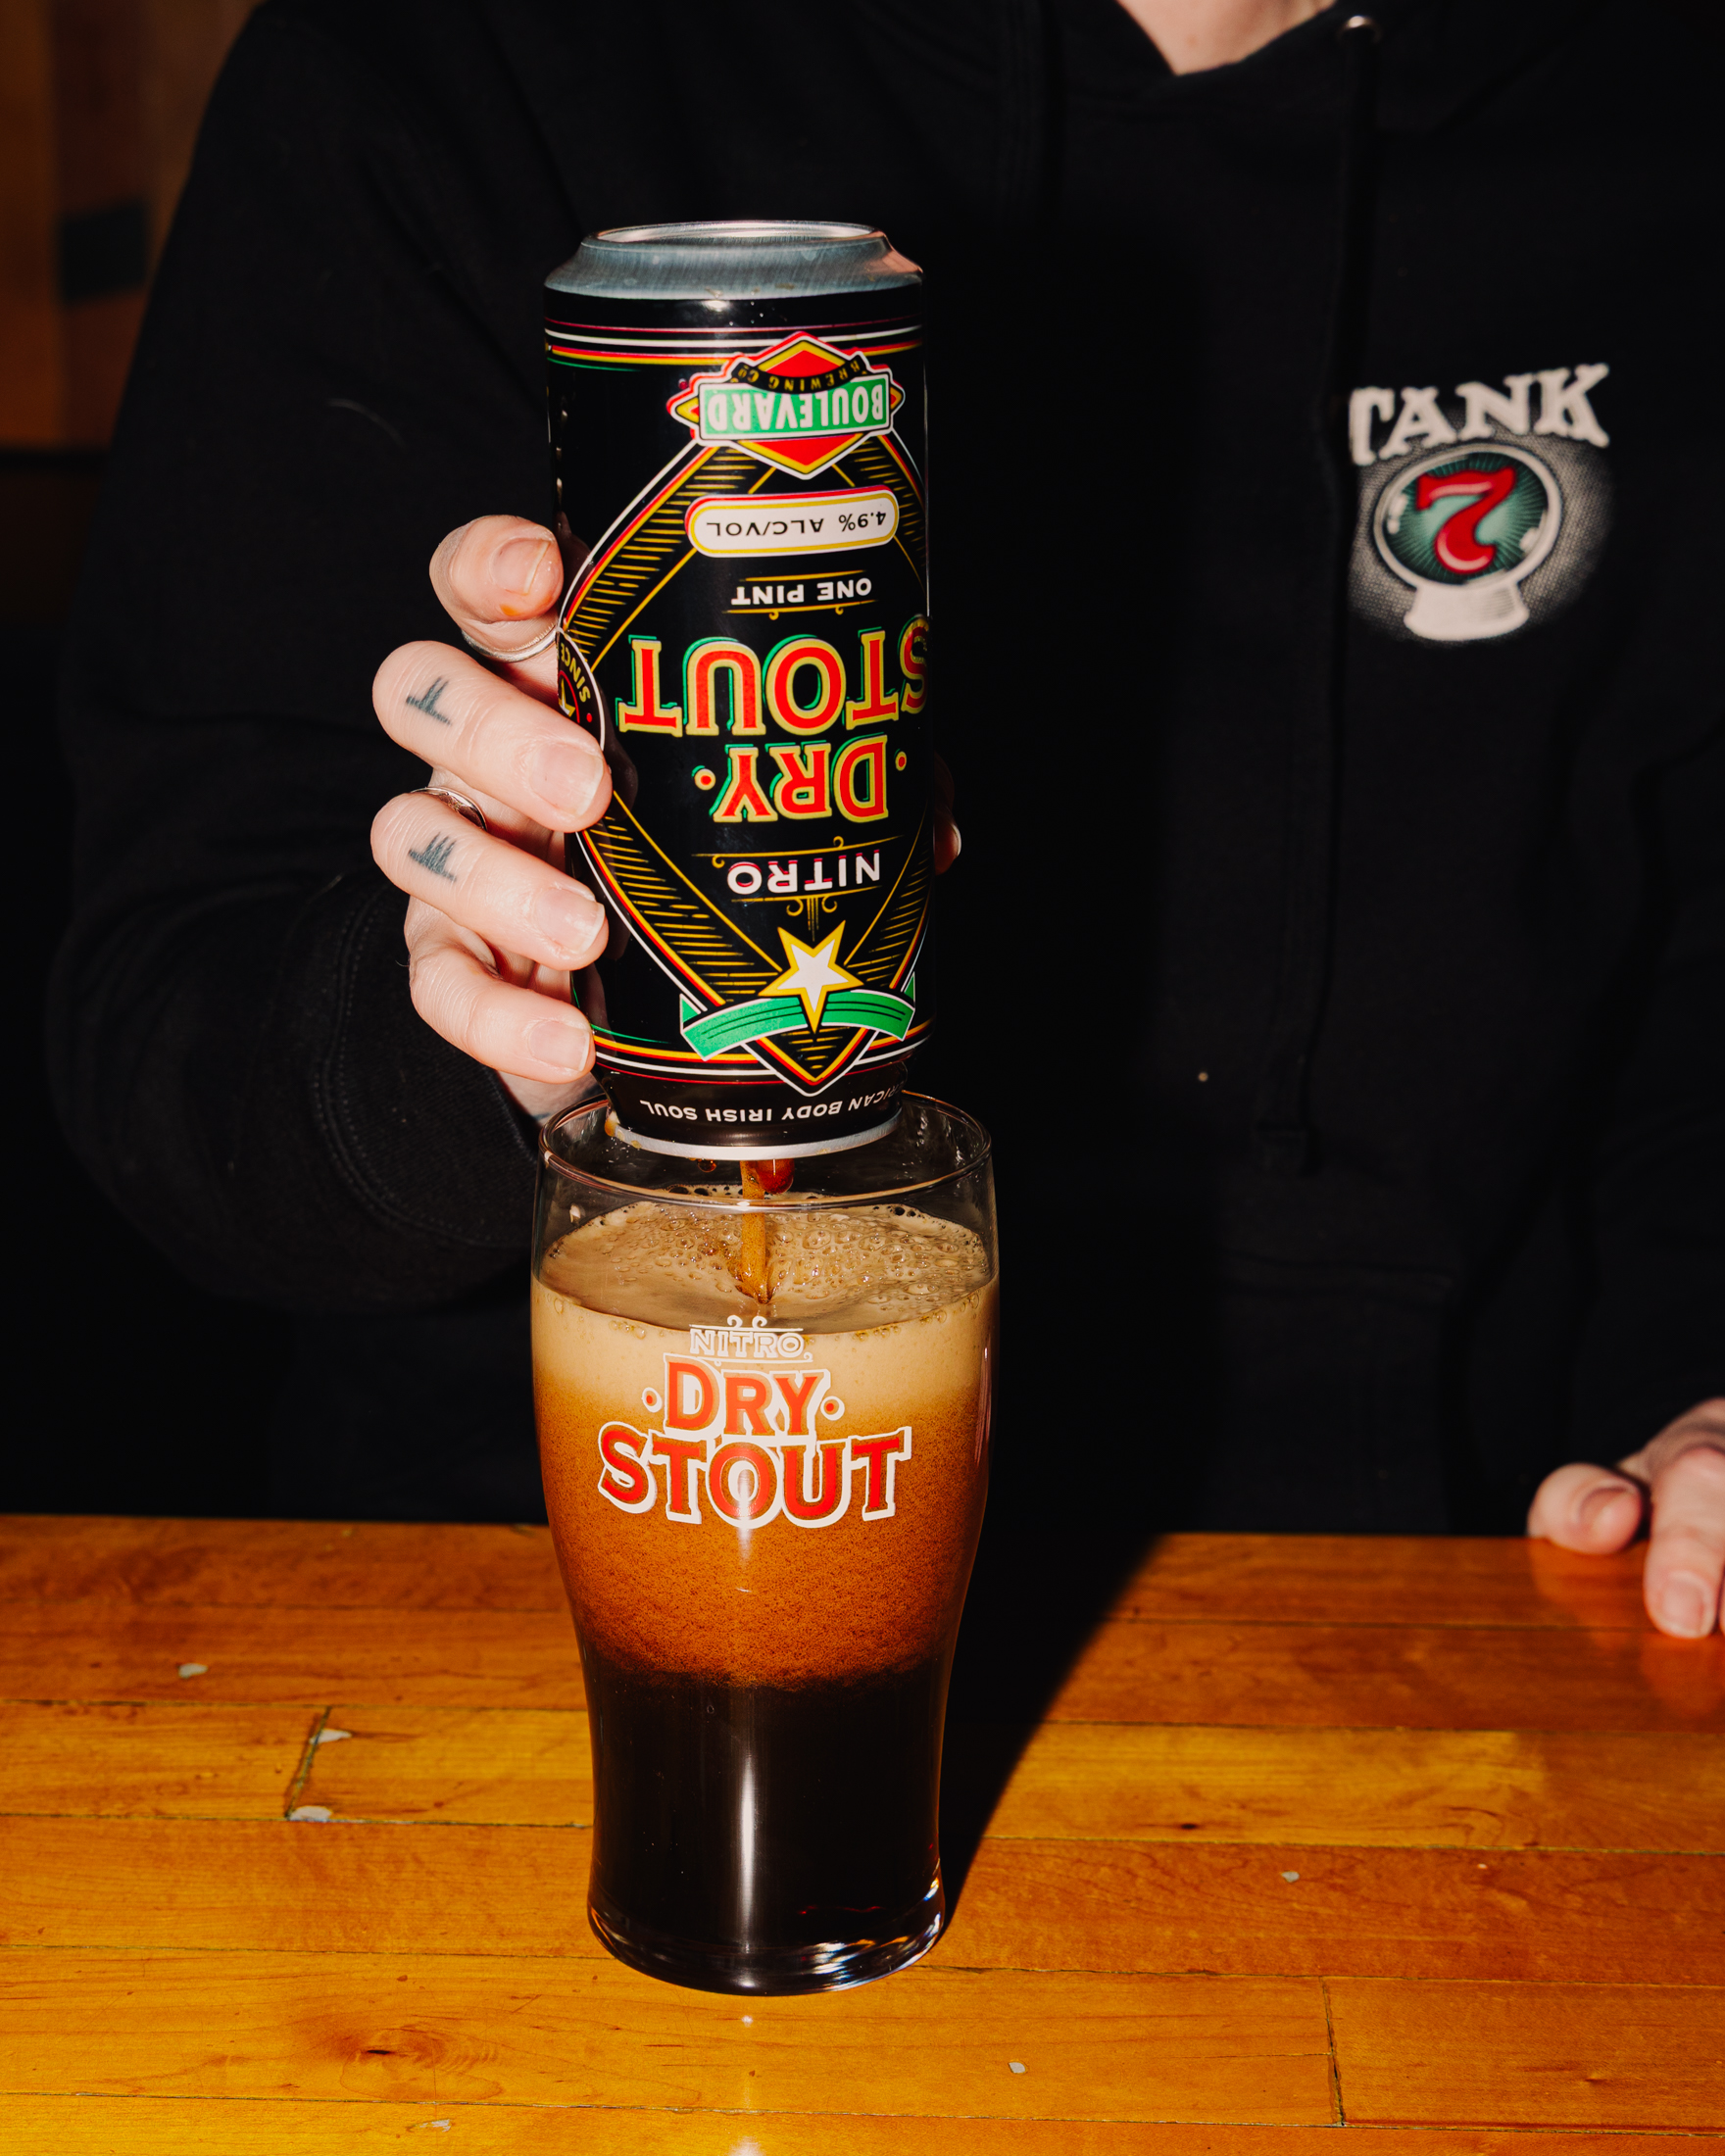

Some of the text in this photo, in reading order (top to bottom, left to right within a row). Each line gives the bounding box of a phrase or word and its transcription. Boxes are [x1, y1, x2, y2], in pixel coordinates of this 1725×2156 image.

[768, 360, 861, 392] BREWING
[708, 383, 883, 432] BOULEVARD
[1349, 362, 1610, 466] TANK
[706, 511, 887, 537] 4.9% ALC/VOL
[1415, 466, 1517, 575] 7
[730, 577, 873, 606] ONE PINT
[560, 641, 592, 704] SINCE
[615, 613, 929, 738] STOUT
[709, 731, 889, 823] DRY
[726, 850, 881, 896] NITRO
[639, 1099, 699, 1121] SOUL
[705, 1107, 772, 1122] IRISH
[781, 1100, 844, 1121] BODY
[689, 1328, 806, 1358] NITRO
[663, 1352, 832, 1438] DRY
[597, 1420, 912, 1530] STOUT
